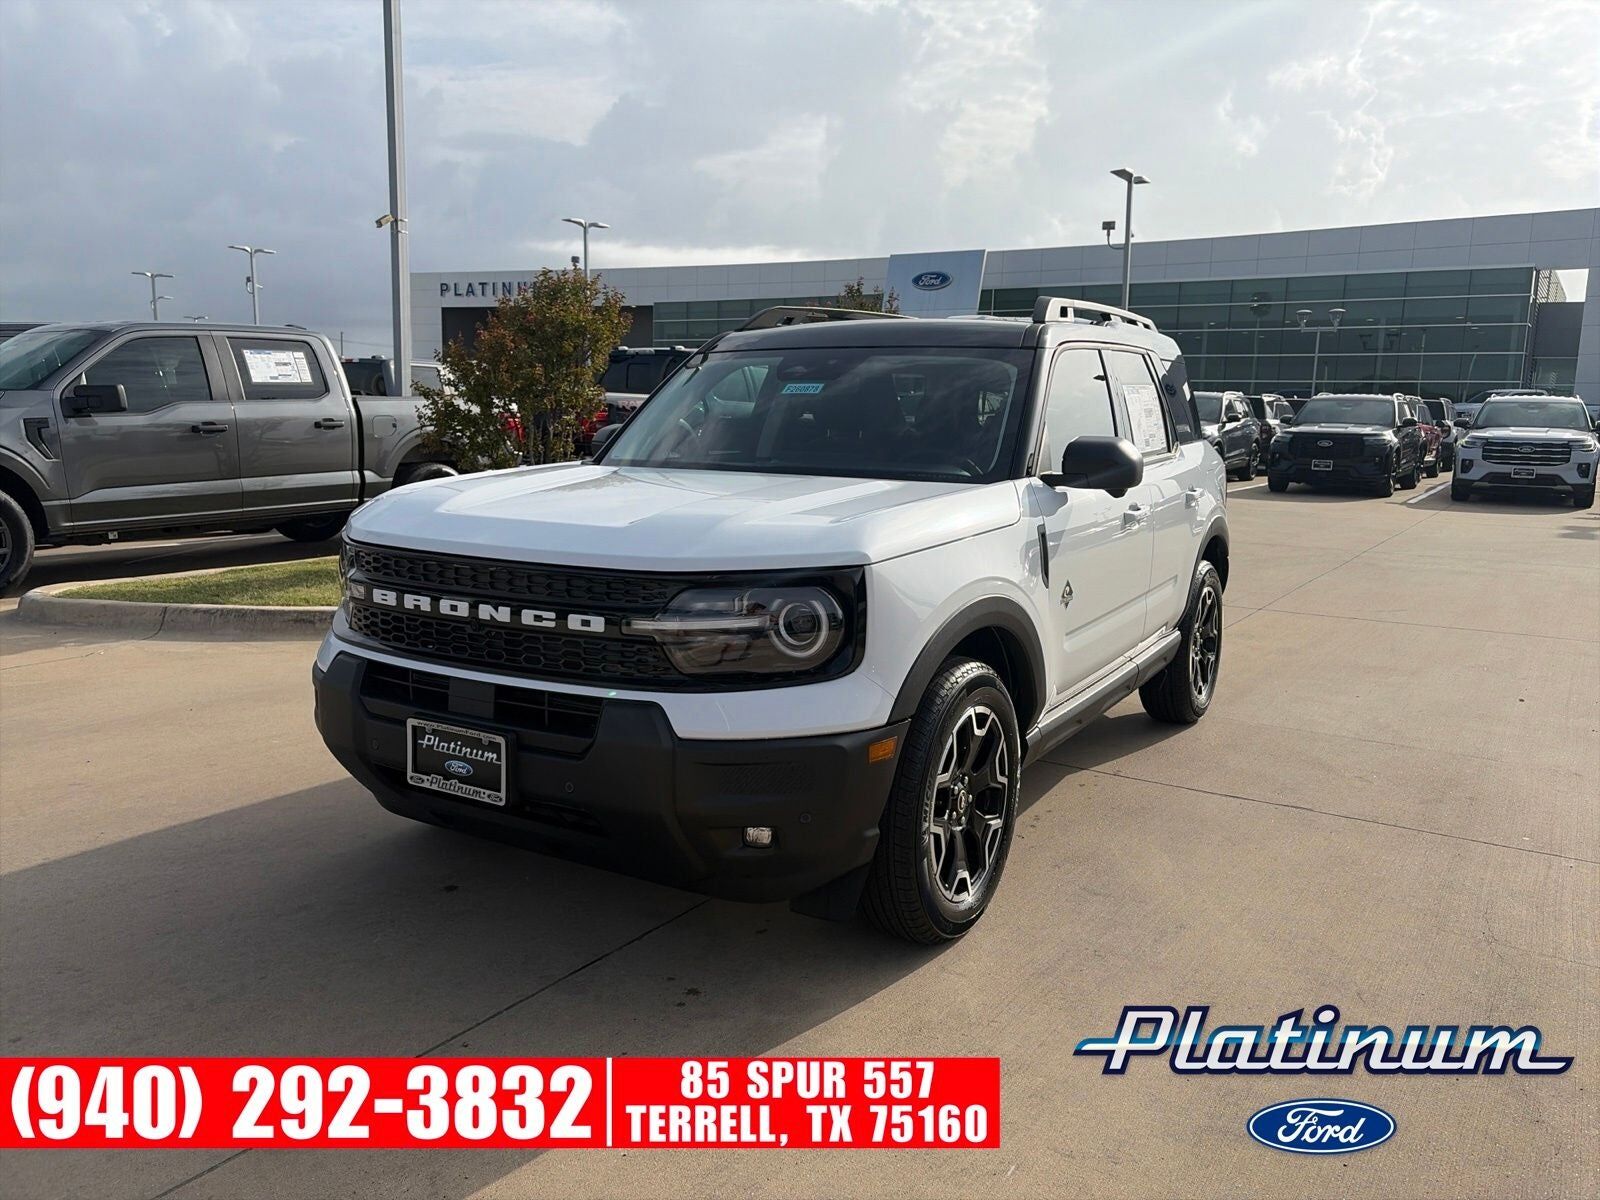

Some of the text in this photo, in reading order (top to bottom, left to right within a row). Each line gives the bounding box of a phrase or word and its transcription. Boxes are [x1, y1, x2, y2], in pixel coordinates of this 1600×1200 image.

[918, 274, 942, 286] Ford
[372, 588, 605, 633] BRONCO
[418, 734, 502, 764] Platinum
[429, 776, 485, 799] Platinum
